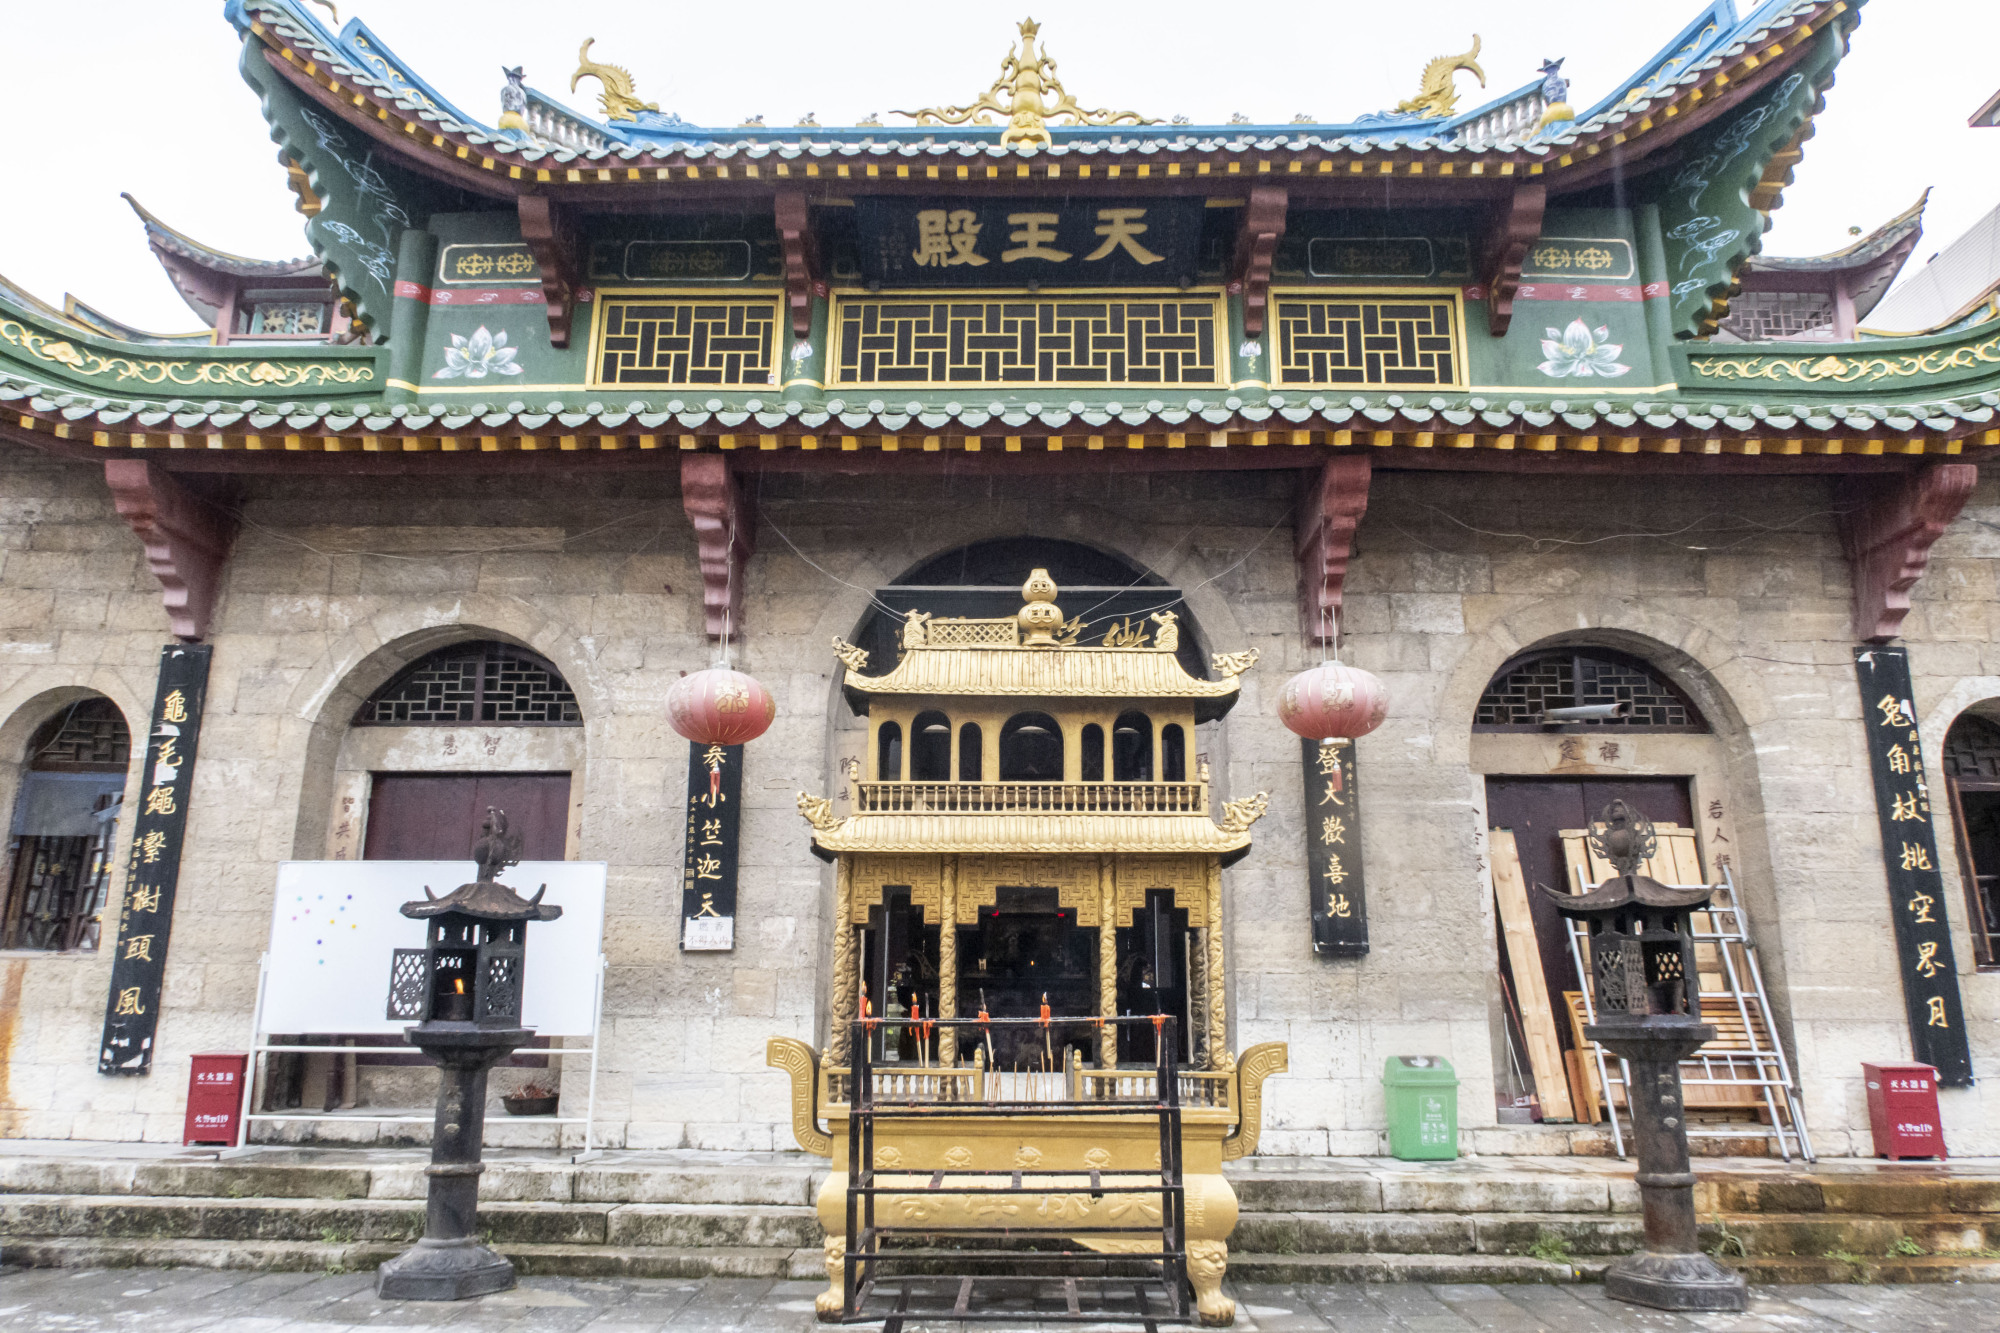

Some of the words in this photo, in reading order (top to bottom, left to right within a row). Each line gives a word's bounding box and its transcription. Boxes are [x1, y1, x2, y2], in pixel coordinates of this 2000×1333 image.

[912, 208, 1166, 267] 天王殿
[443, 735, 501, 756] 智慧
[1306, 747, 1351, 918] 登大歡喜地
[1877, 694, 1949, 1028] 兔角杖挑空界月
